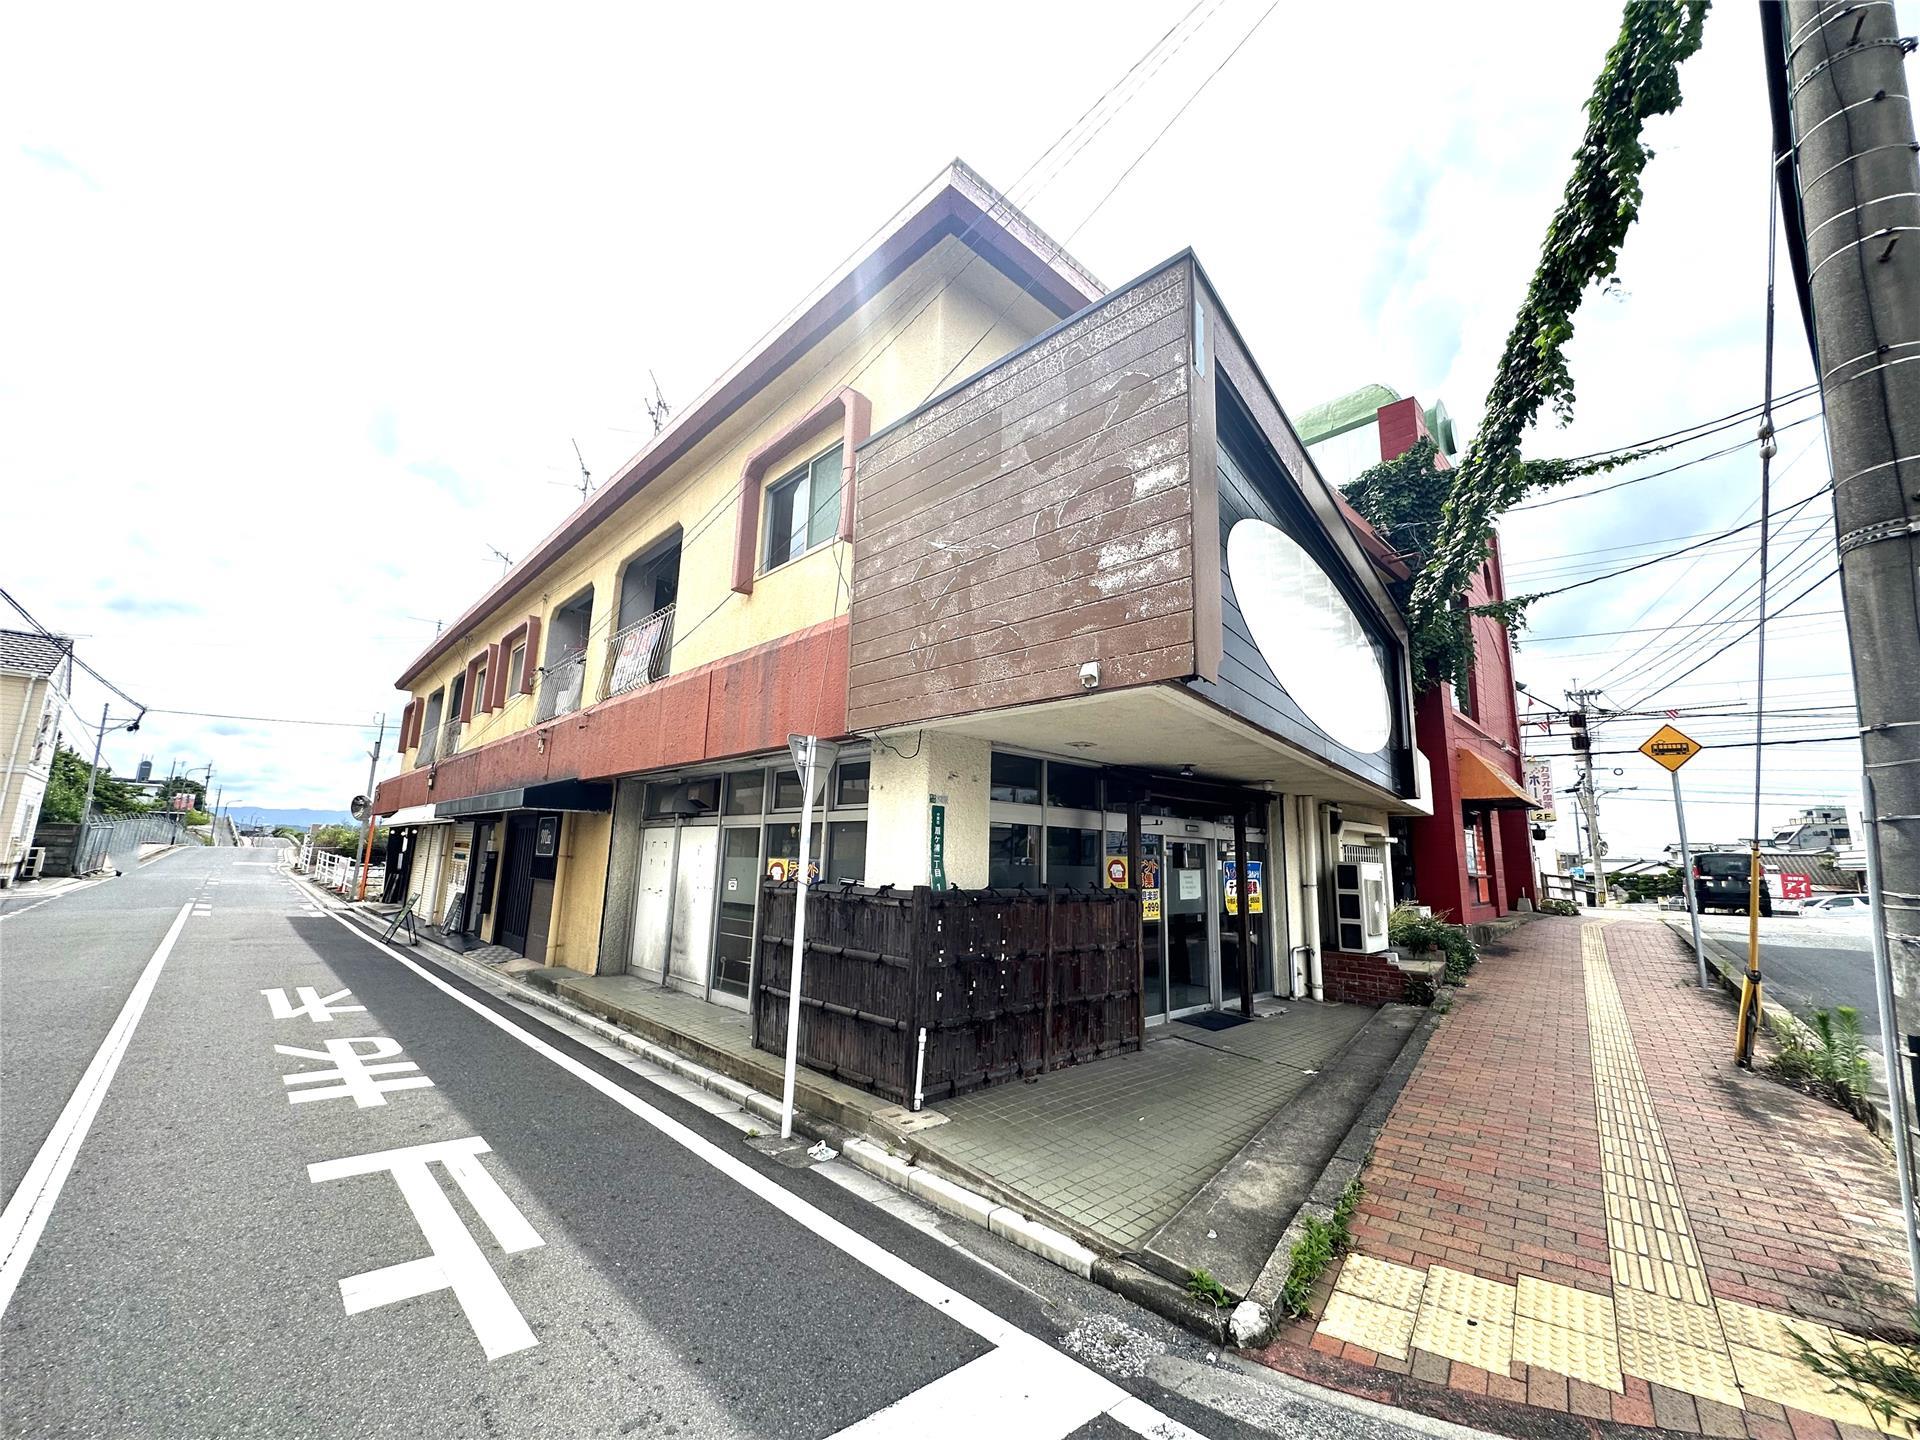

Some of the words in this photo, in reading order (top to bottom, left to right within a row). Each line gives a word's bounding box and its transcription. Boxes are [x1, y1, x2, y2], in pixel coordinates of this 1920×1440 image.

[1540, 766, 1553, 810] カラオケ喫茶
